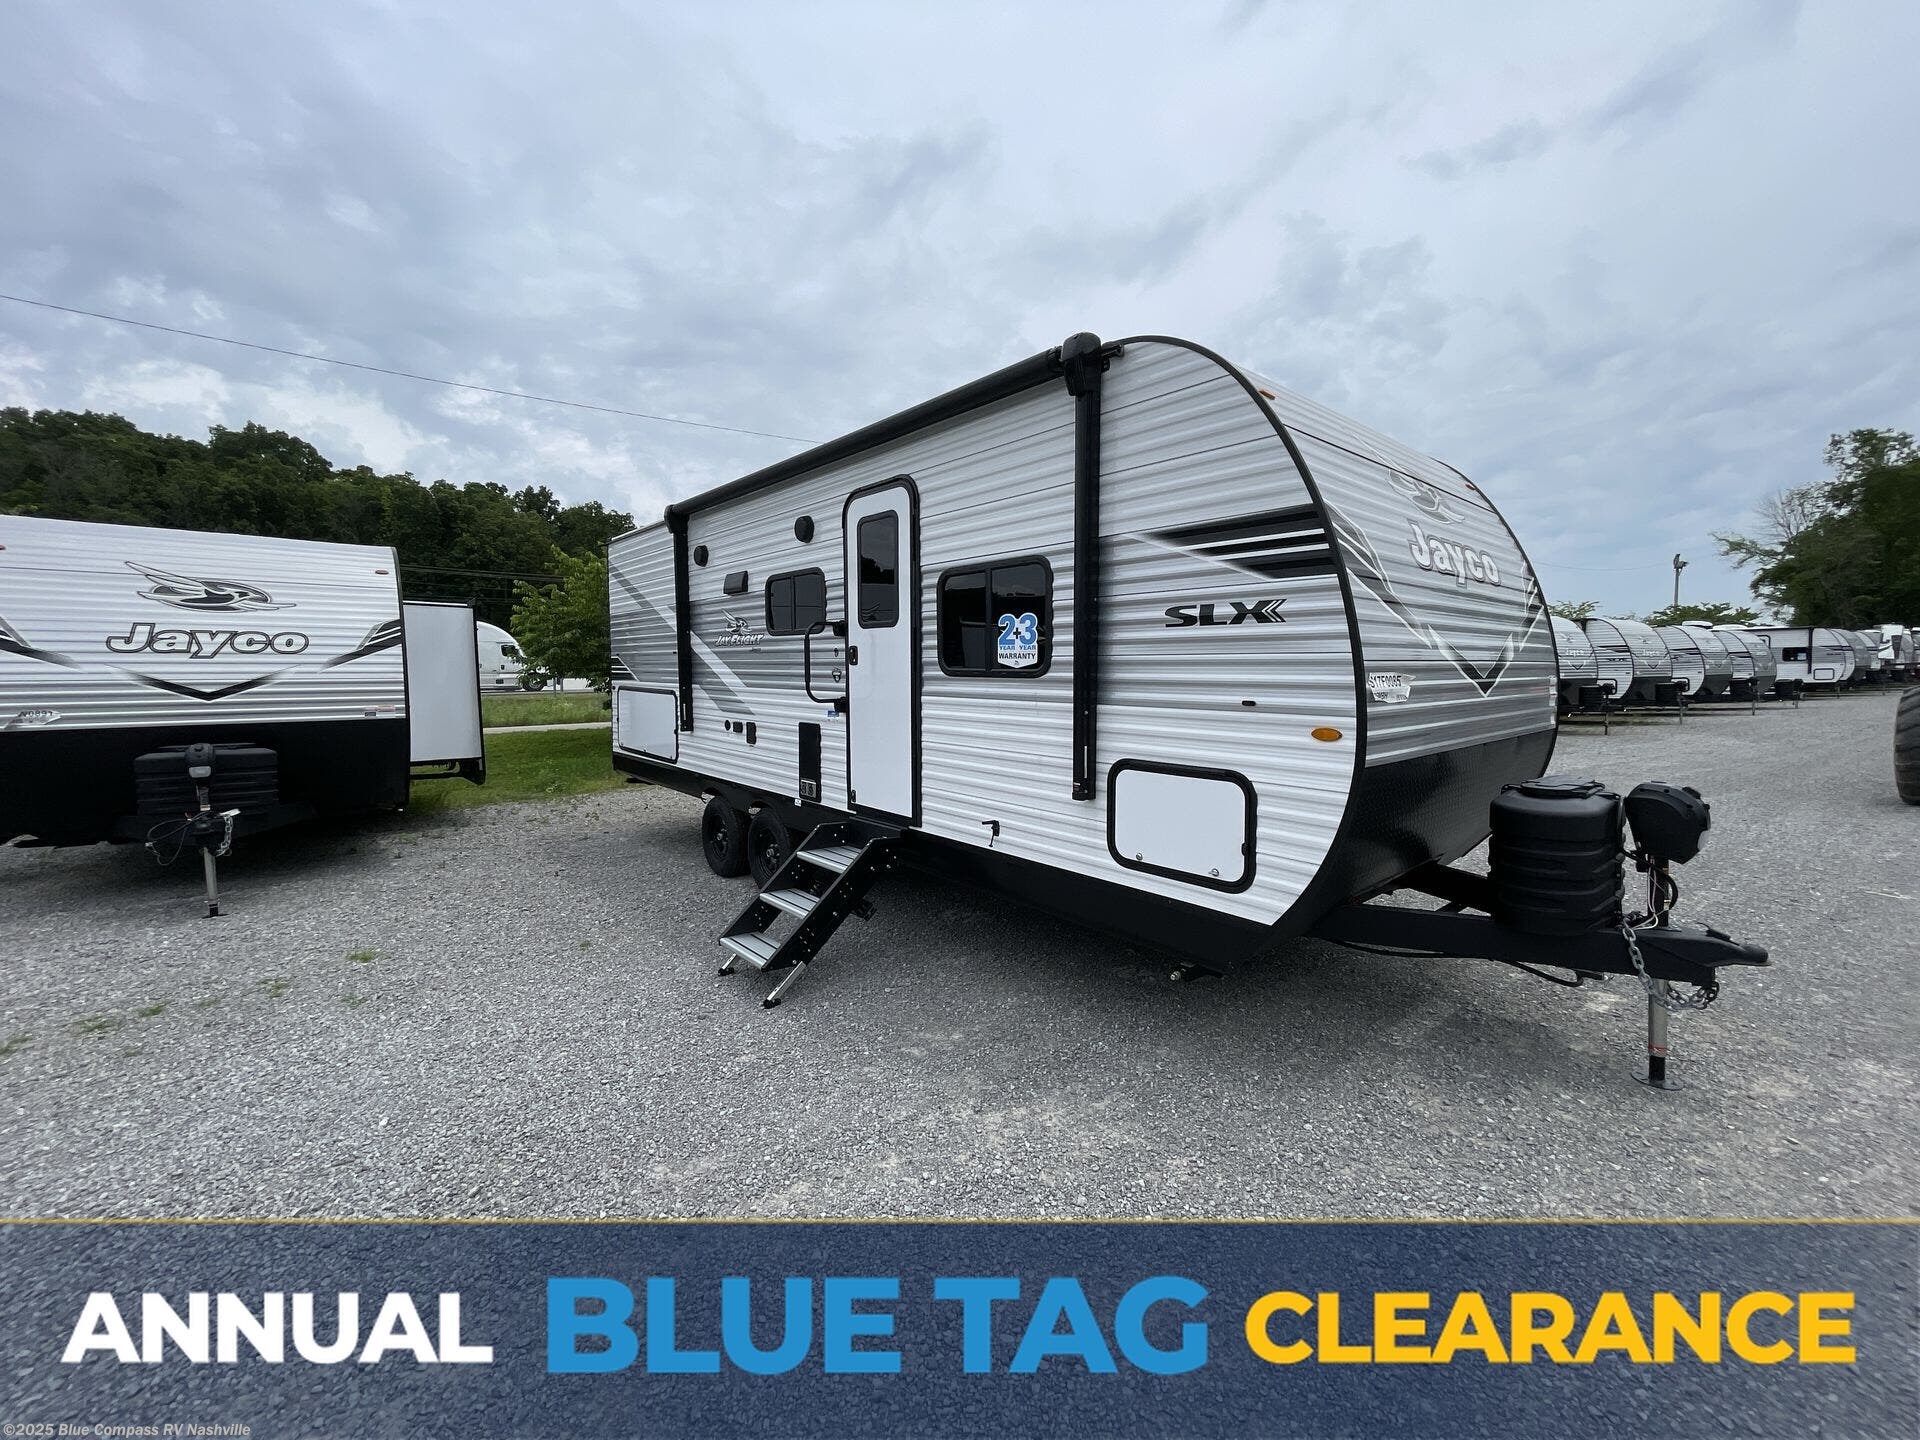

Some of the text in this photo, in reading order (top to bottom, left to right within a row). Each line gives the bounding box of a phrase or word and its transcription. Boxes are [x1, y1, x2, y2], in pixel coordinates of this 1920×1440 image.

[1407, 518, 1501, 588] Jayco
[1164, 598, 1287, 627] SLX
[106, 622, 309, 658] Jayco
